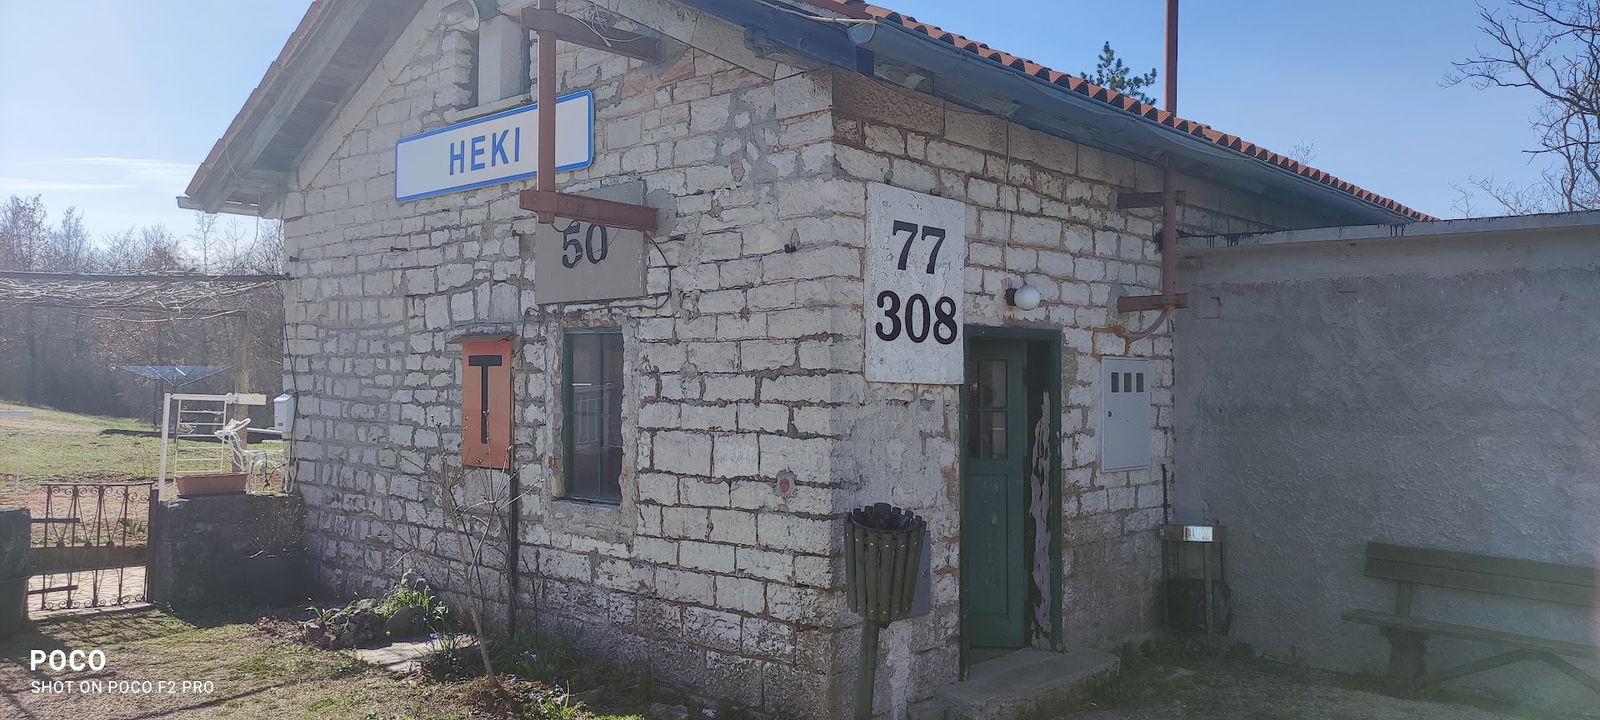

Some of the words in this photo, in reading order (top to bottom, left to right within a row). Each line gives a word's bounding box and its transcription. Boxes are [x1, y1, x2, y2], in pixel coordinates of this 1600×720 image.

[450, 127, 520, 175] HEKI
[561, 222, 608, 268] 50
[892, 220, 946, 274] 77
[875, 291, 958, 345] 308
[468, 355, 502, 444] T
